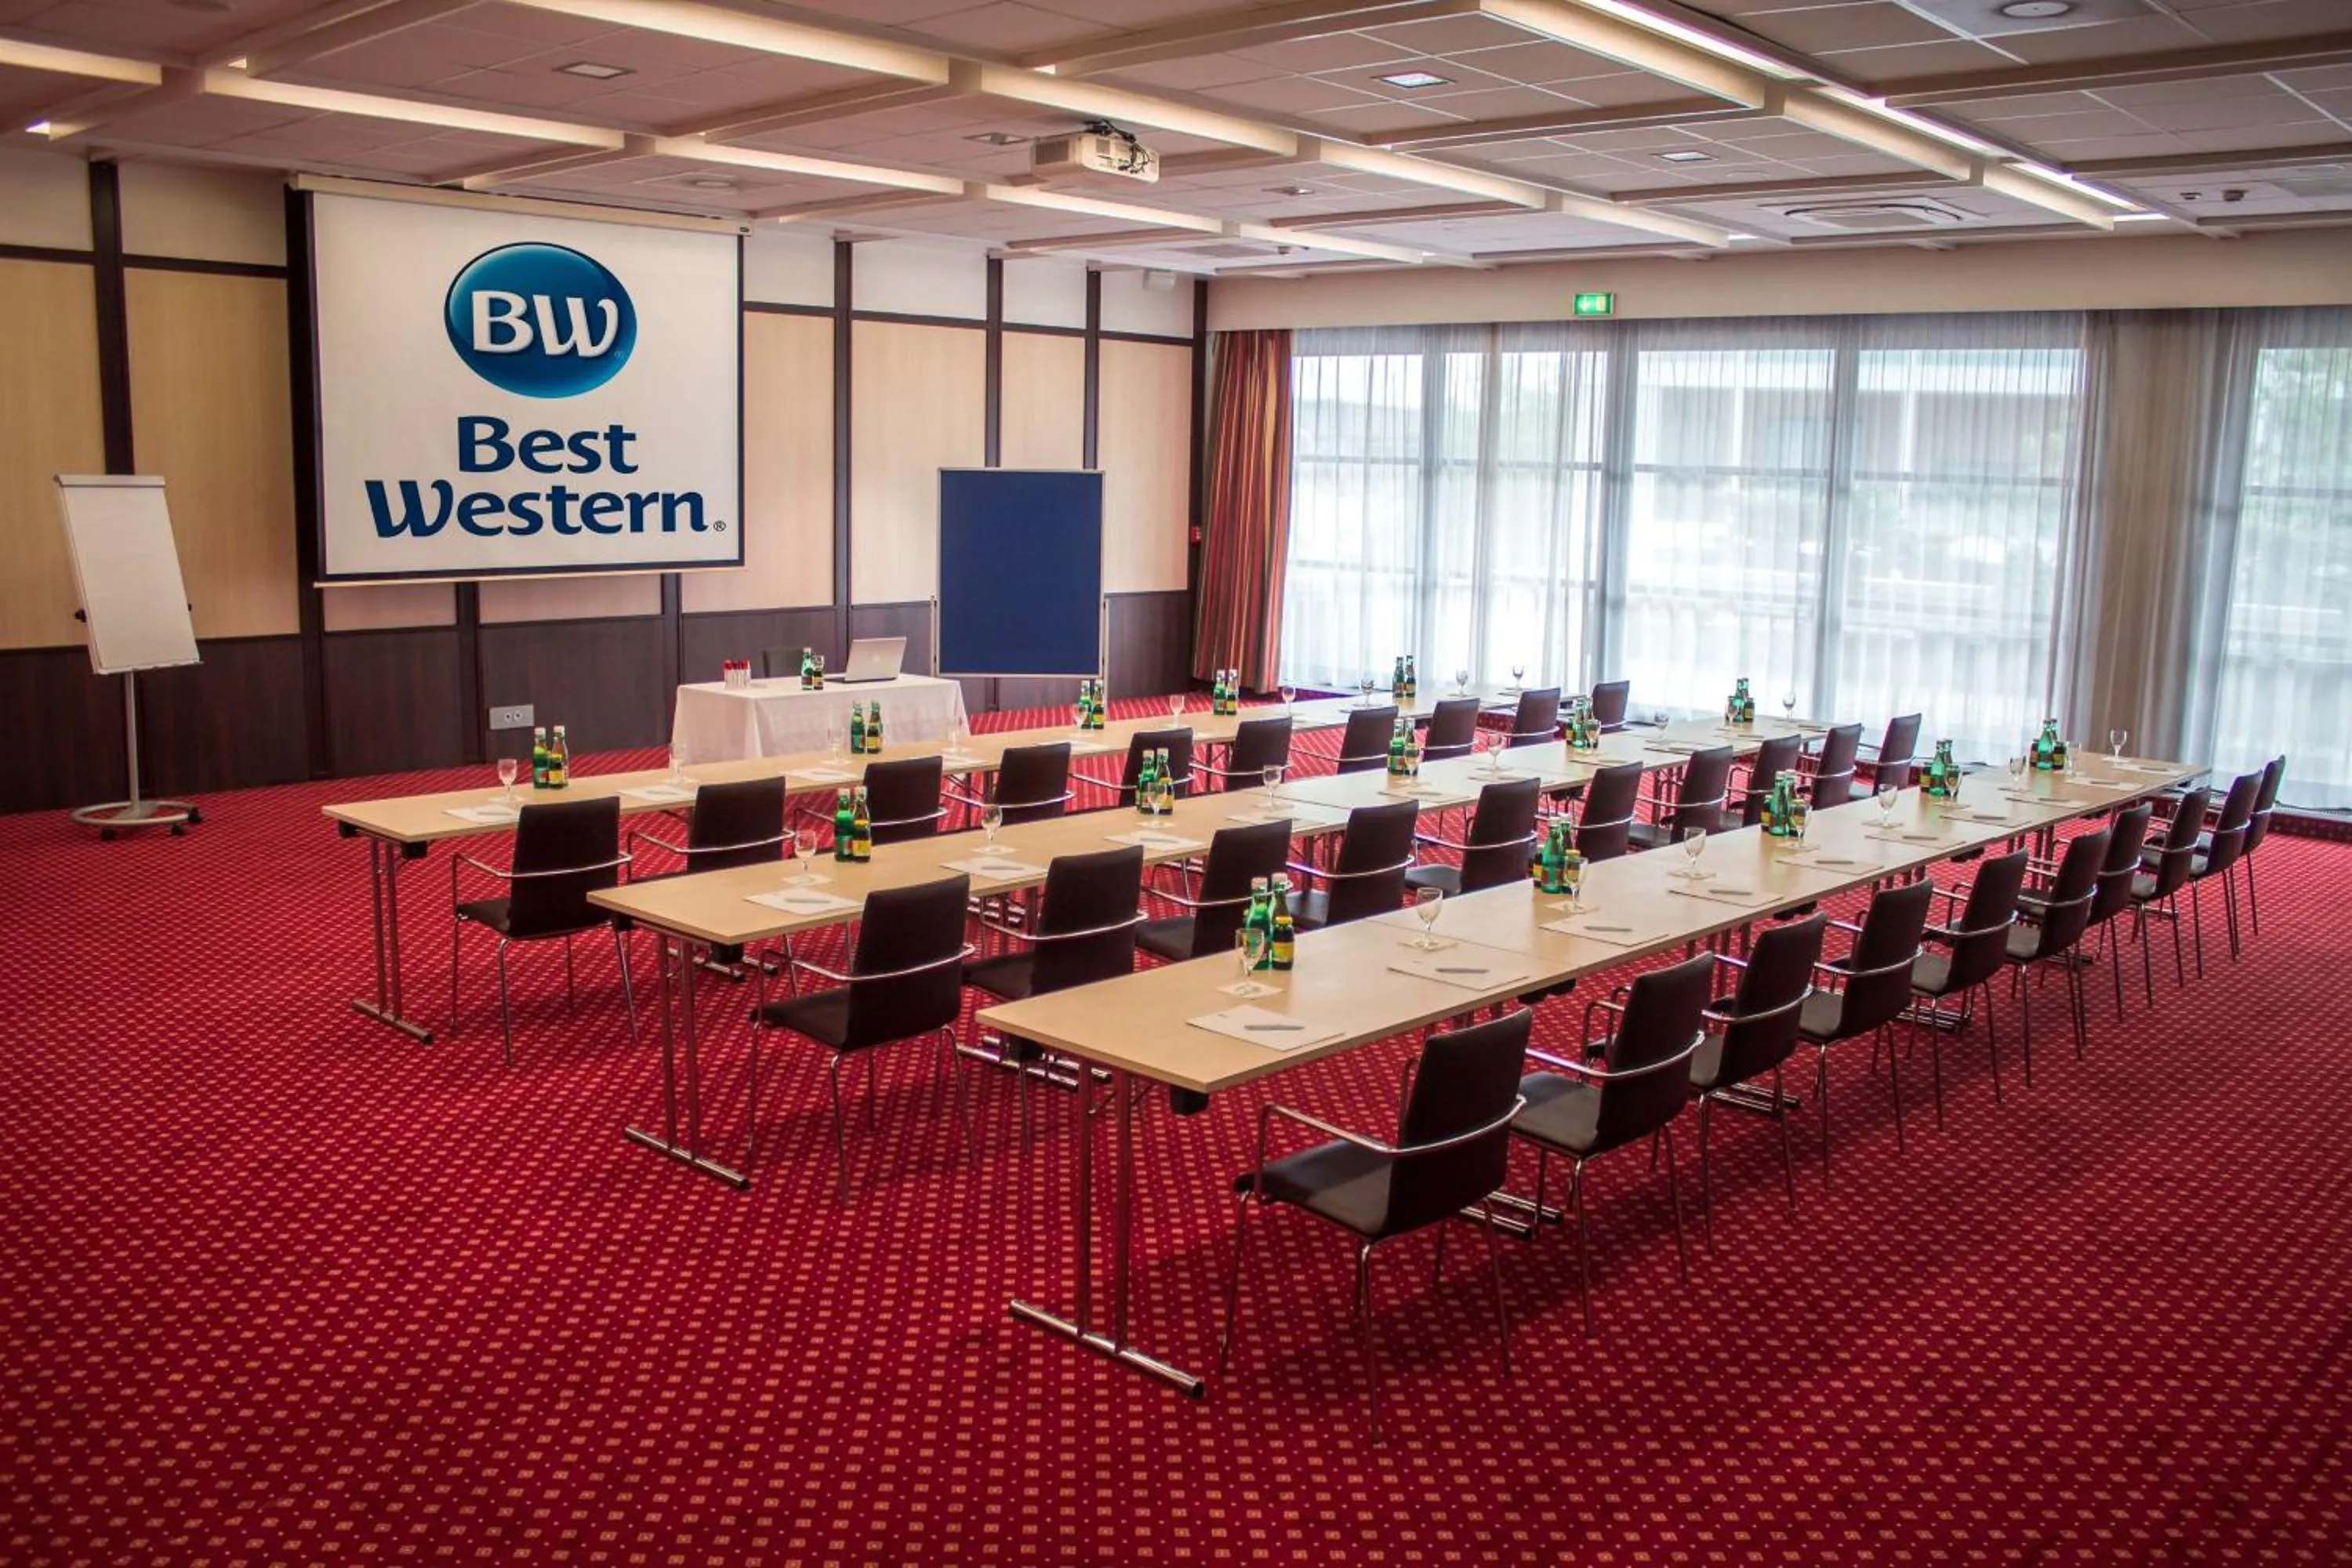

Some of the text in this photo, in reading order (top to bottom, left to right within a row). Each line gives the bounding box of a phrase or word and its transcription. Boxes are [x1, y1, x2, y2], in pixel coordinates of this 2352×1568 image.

[472, 289, 619, 358] BW
[457, 416, 639, 474] Best
[365, 479, 709, 538] Western
